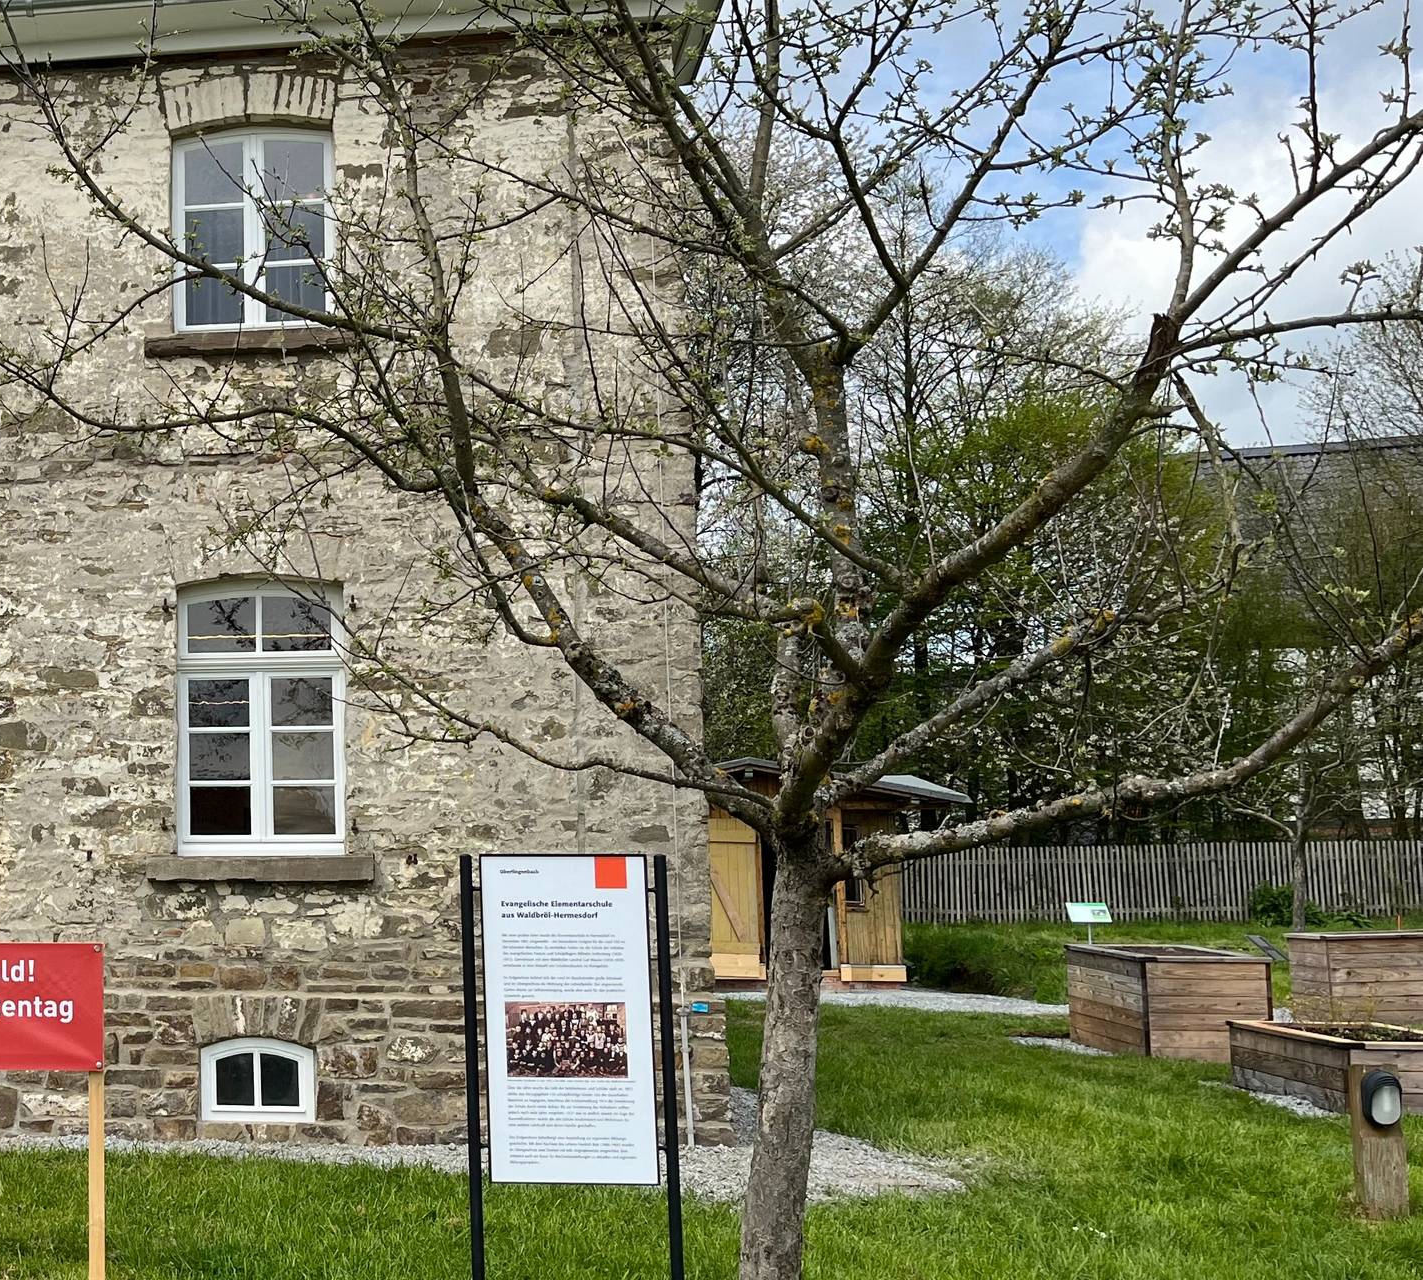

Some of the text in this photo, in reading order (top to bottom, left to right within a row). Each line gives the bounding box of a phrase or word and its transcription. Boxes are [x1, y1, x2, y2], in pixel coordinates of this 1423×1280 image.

[501, 900, 613, 909] Evangelische Elementarschule
[517, 911, 599, 919] Waldbröl-Hermesdorf
